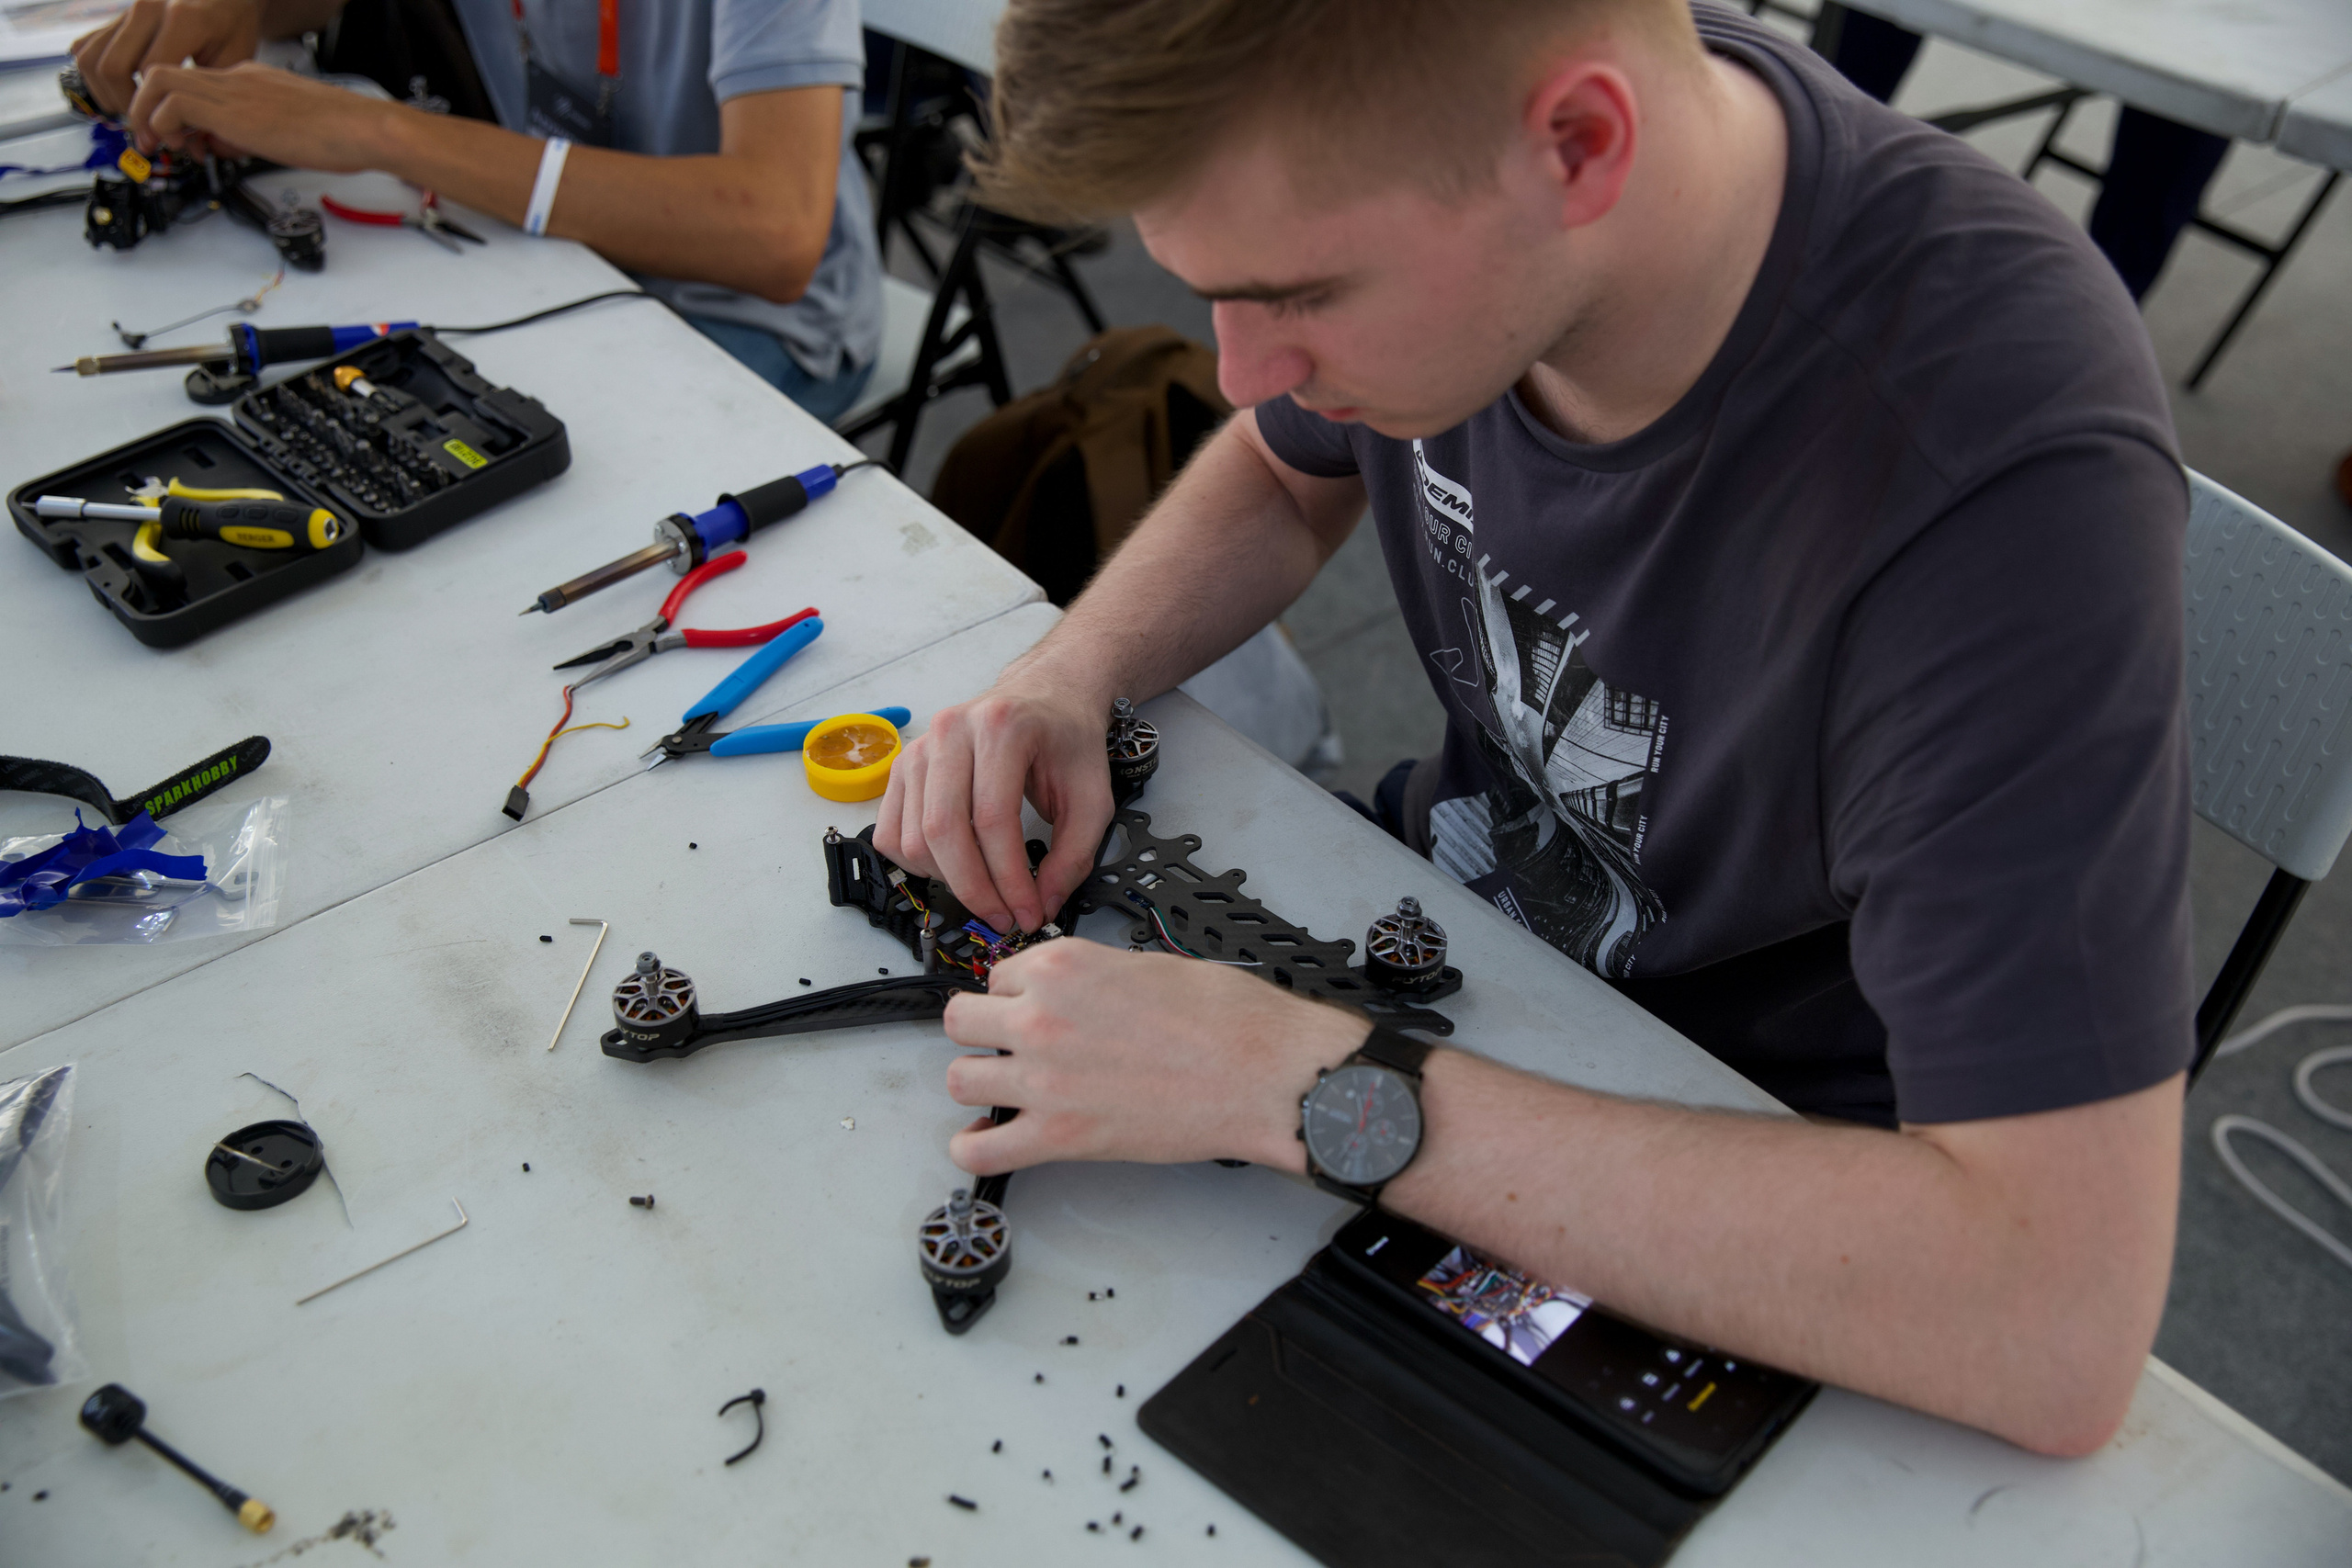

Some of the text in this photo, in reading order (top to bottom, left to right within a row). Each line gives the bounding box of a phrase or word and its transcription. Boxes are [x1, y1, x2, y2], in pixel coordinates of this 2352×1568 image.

[1424, 506, 1473, 559] OUR CI
[1650, 715, 1669, 773] RUN YOUR CITY
[144, 754, 239, 817] SPARKHOBBY
[1638, 814, 1648, 833] CITY
[1633, 832, 1645, 853] YOUR
[1498, 890, 1518, 919] URBAN
[1624, 953, 1636, 971] CITY
[617, 1023, 661, 1042] LYTOP
